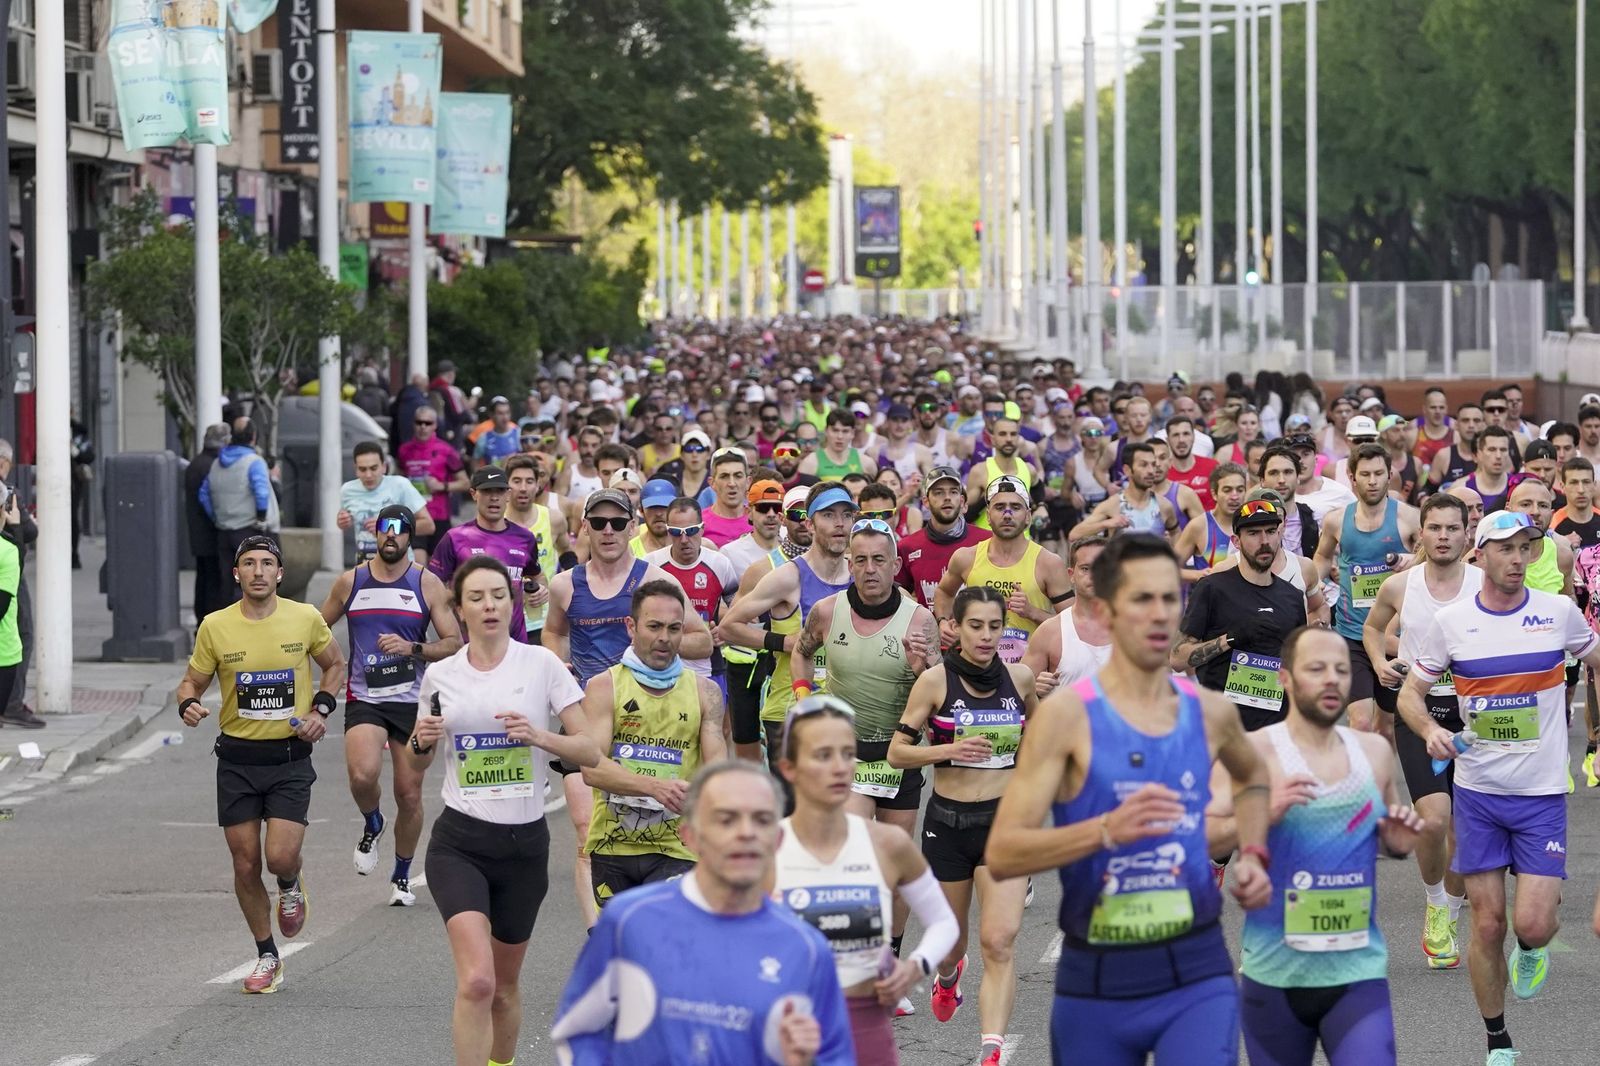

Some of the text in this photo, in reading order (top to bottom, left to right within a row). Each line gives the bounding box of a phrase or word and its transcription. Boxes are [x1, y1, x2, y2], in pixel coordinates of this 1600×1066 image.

[1521, 615, 1554, 627] Metz
[223, 650, 247, 659] PROYECTO
[1251, 657, 1281, 669] ZURICH
[382, 665, 398, 674] 5342
[255, 671, 289, 681] ZURICH
[1249, 673, 1267, 682] 2568
[257, 688, 275, 696] 3747
[1226, 681, 1283, 700] JOAO THEOTO
[250, 697, 284, 709] MANU
[1491, 696, 1530, 707] ZURICH
[977, 713, 1014, 722] ZURICH
[1493, 715, 1514, 725] 3254
[1489, 727, 1520, 739] THIB
[637, 748, 675, 761] ZURICH
[482, 755, 505, 766] 2698
[866, 762, 884, 770] 1877
[465, 767, 525, 785] CAMILLE
[635, 766, 657, 777] 2793
[1121, 874, 1177, 891] ZURICH
[1316, 872, 1364, 887] ZURICH
[815, 887, 871, 904] ZURICH
[1309, 913, 1353, 932] TONY
